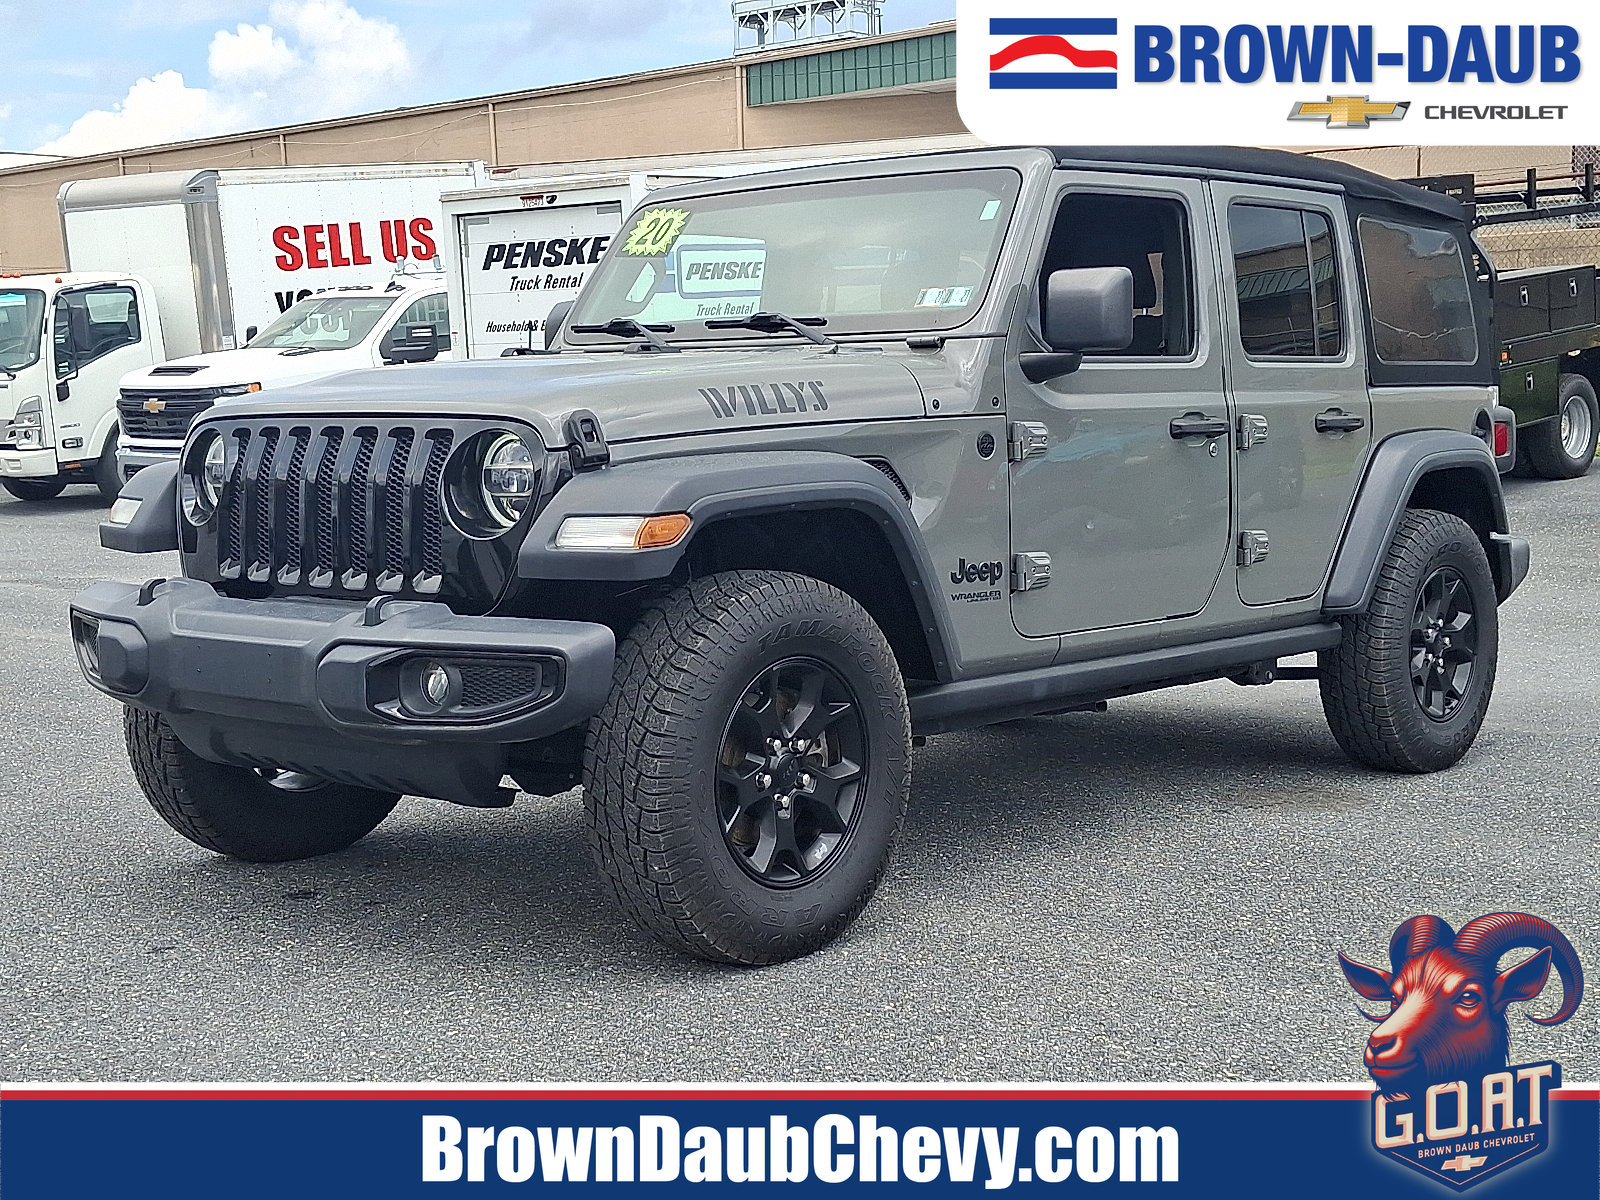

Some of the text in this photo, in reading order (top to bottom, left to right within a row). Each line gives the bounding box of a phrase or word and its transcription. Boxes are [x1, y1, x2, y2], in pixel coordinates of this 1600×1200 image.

[272, 217, 437, 271] SELL US
[635, 217, 675, 246] 20
[482, 236, 611, 271] PENSKE
[510, 272, 584, 291] Truck Rental
[686, 261, 763, 281] PENSKE
[696, 302, 754, 316] Truck Rental
[698, 381, 829, 418] WILLYS
[951, 558, 1003, 585] Jeep
[951, 590, 1002, 601] WRANGLER
